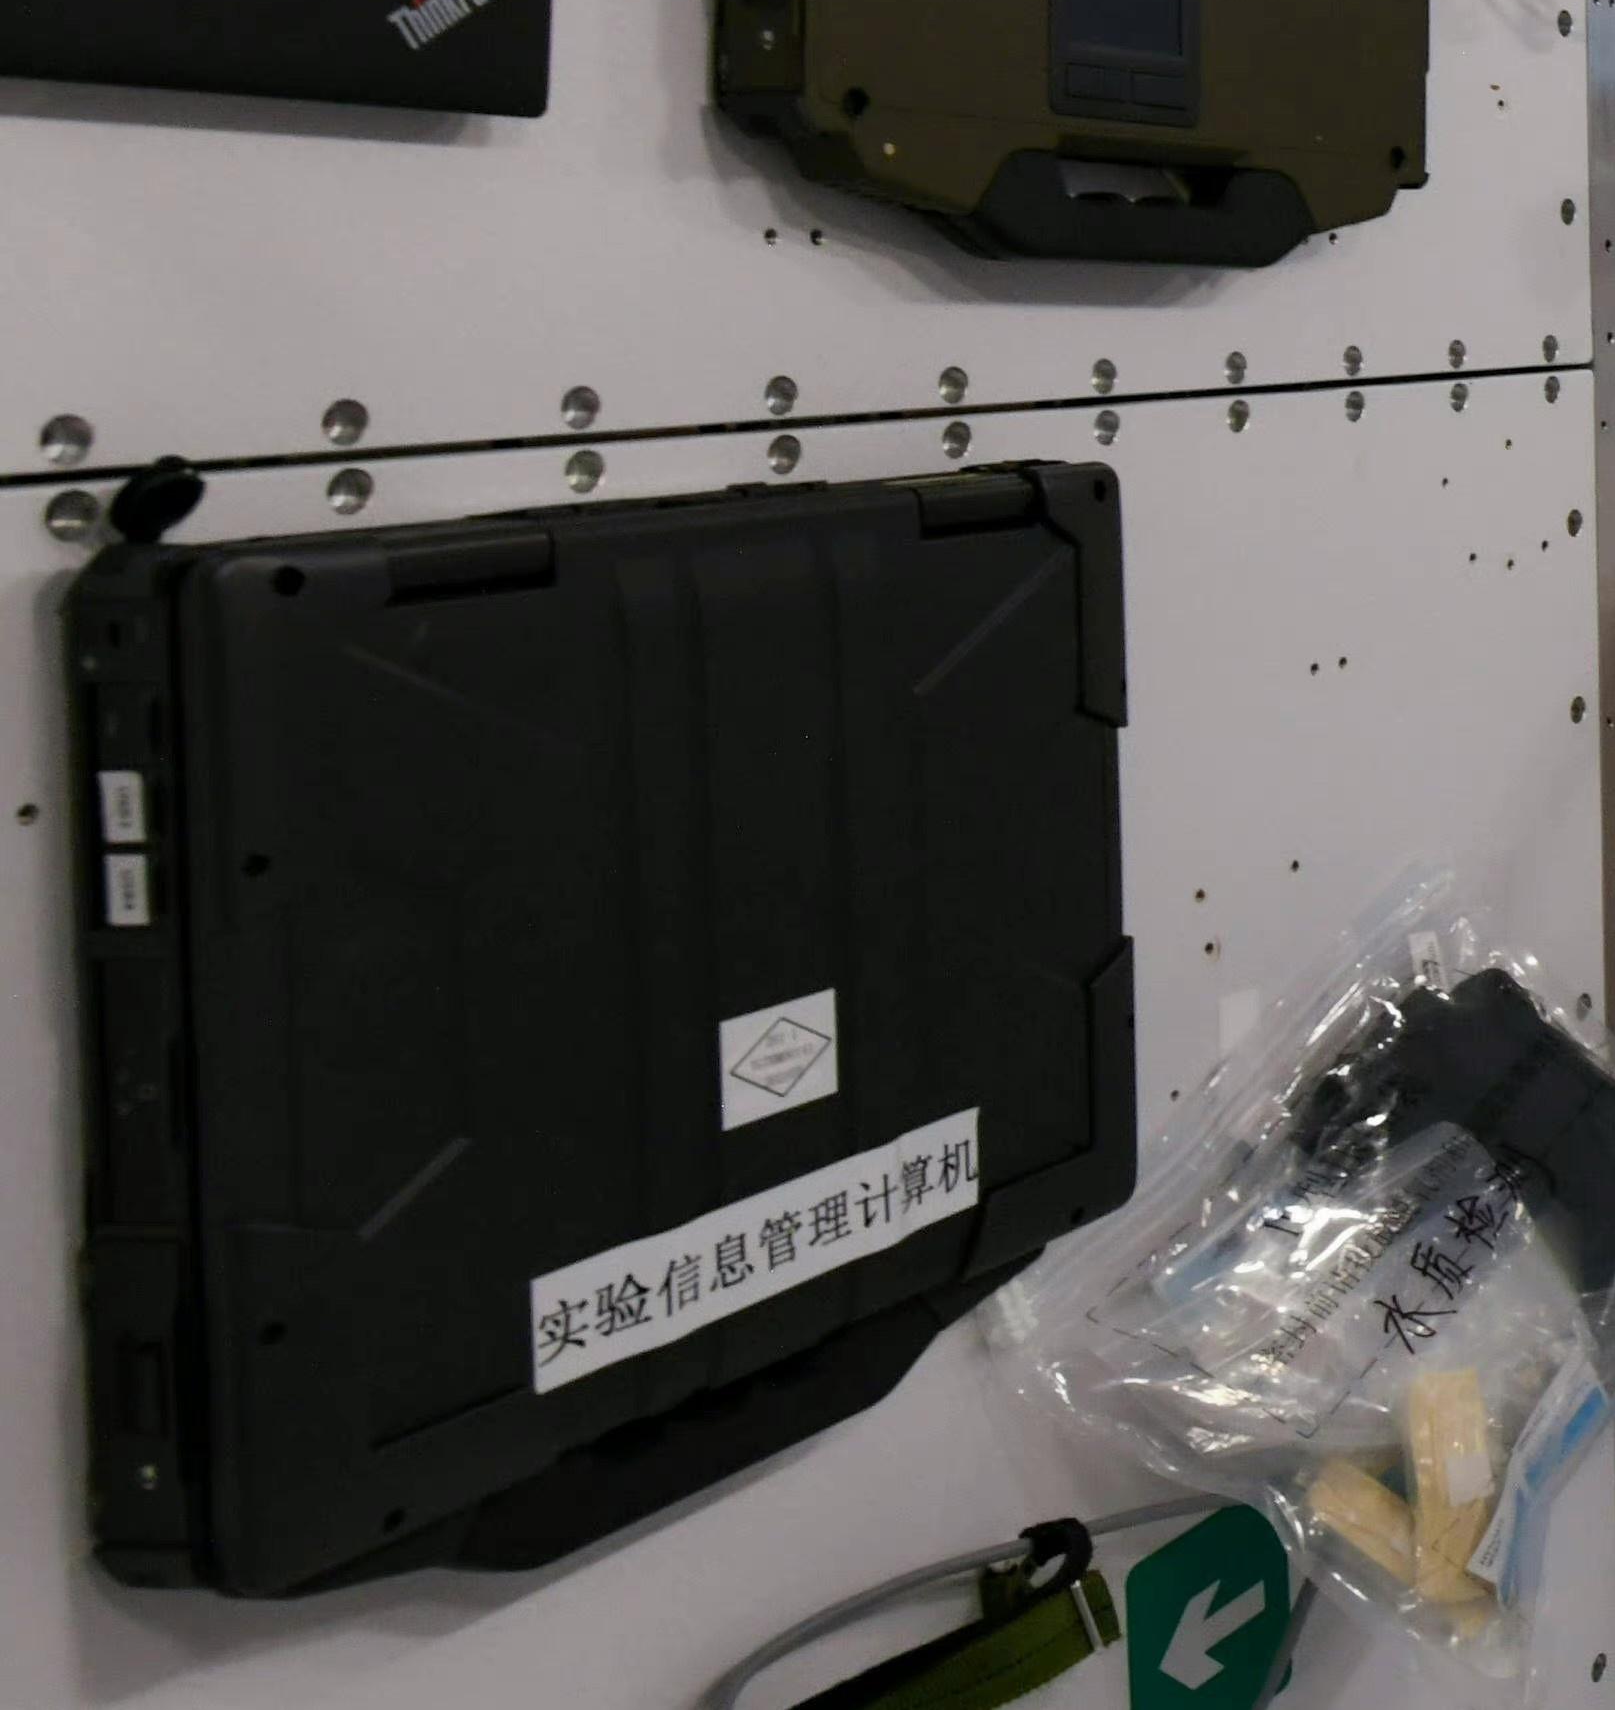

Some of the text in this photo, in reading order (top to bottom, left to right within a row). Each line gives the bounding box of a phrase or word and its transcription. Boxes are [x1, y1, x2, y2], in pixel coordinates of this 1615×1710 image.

[533, 1140, 979, 1370] 实验信息管理计算机
